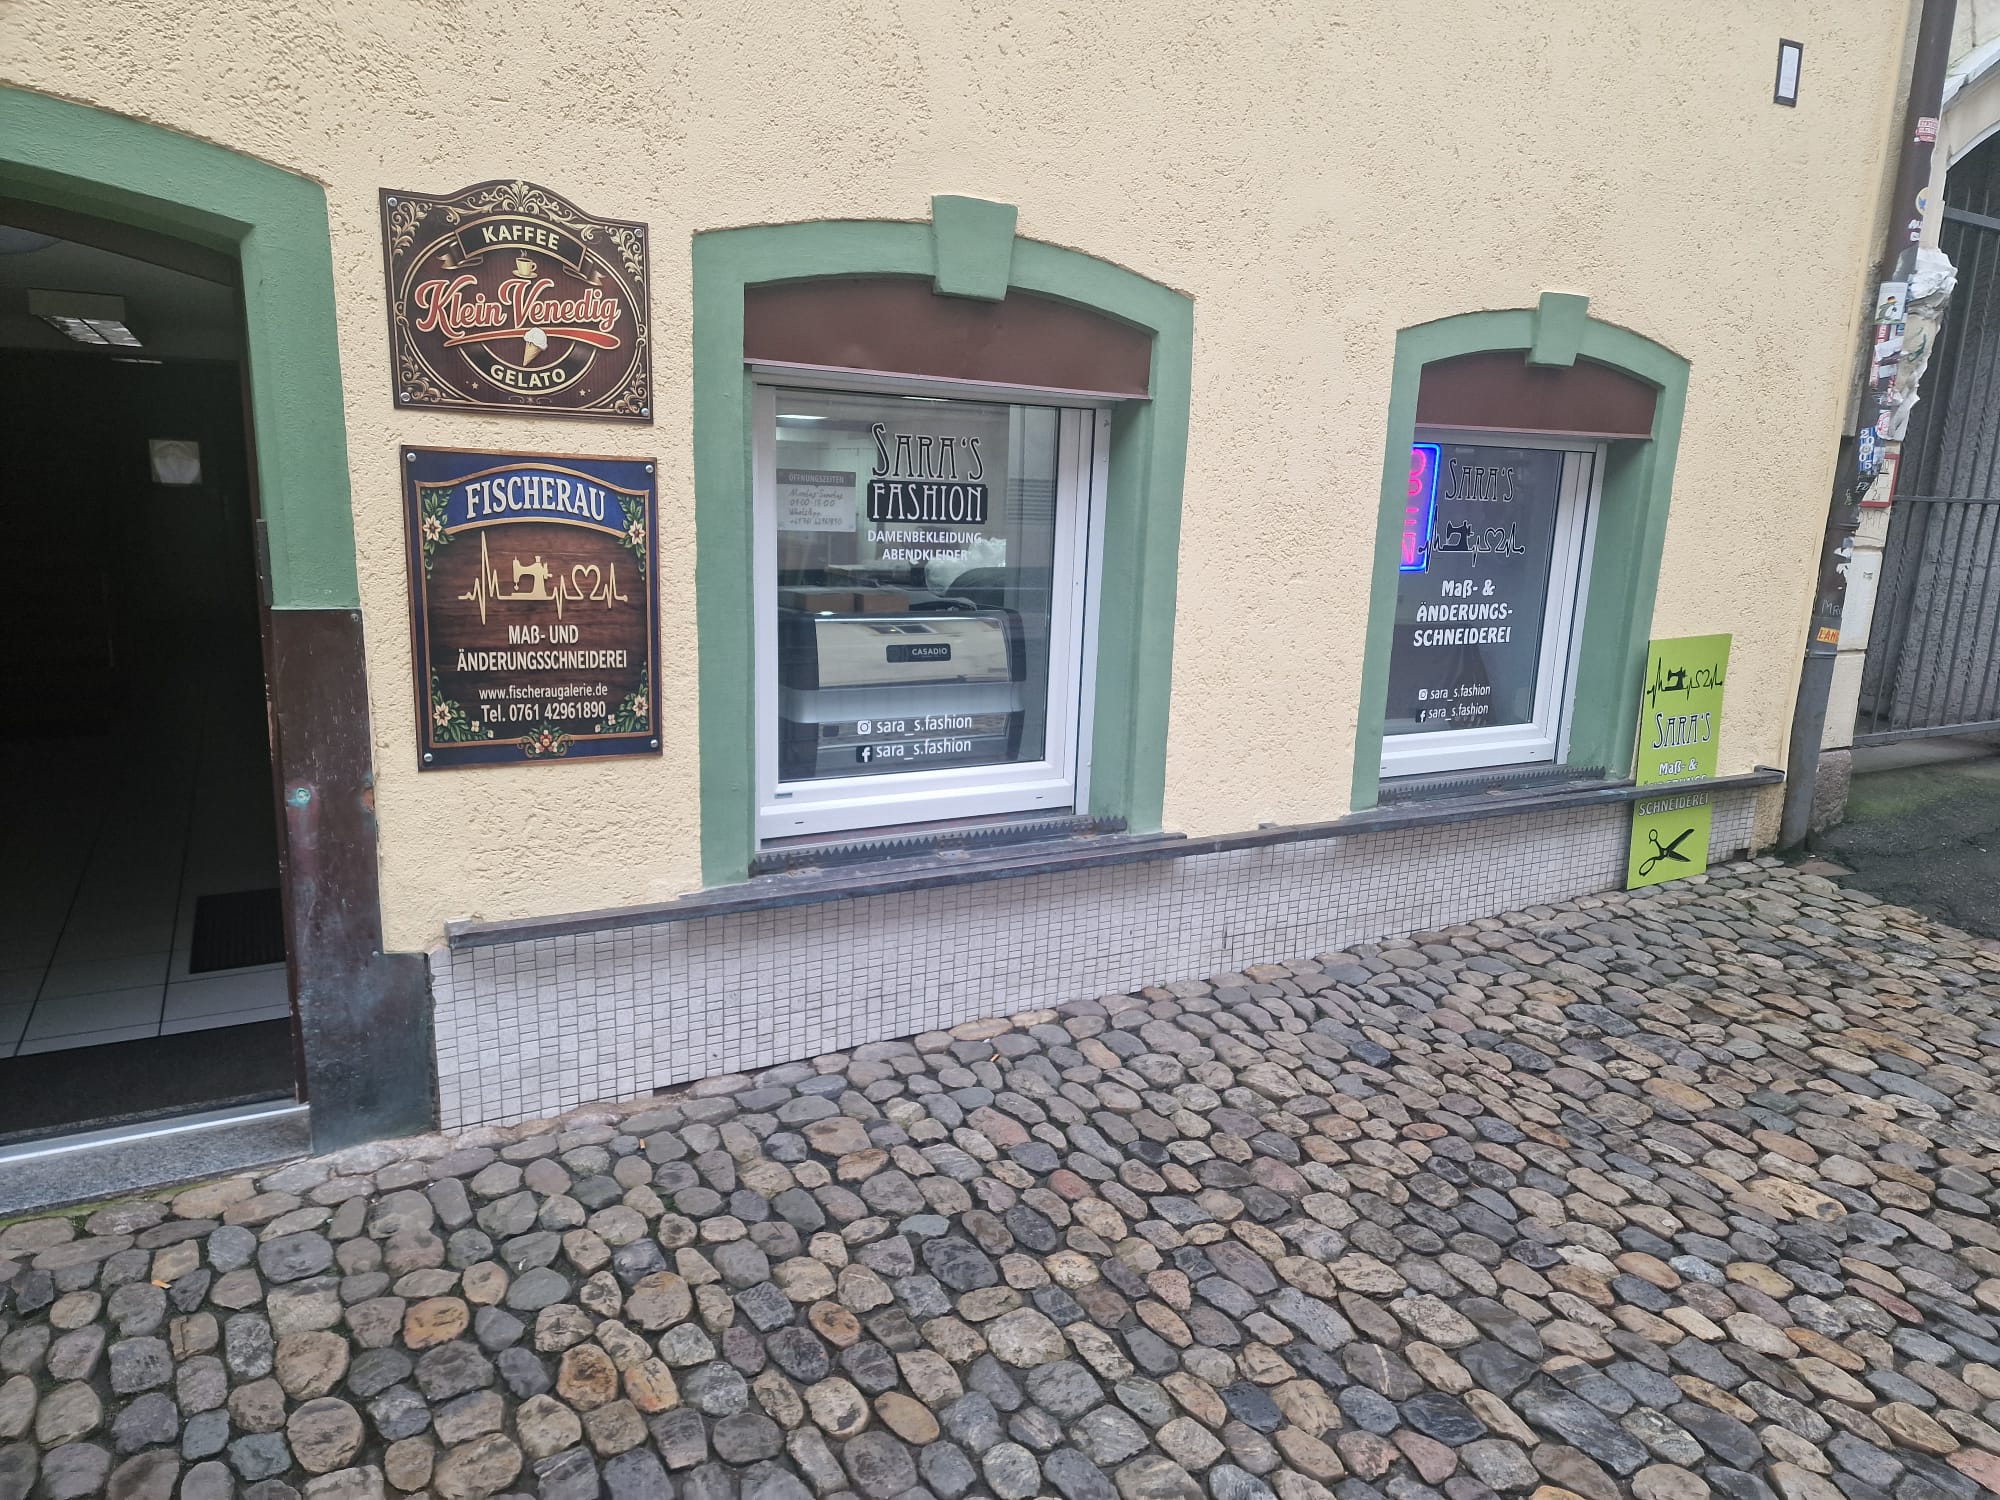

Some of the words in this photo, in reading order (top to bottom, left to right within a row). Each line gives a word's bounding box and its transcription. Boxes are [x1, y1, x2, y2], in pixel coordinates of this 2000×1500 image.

[482, 225, 560, 251] KAFFEE
[415, 275, 507, 339] Klein
[498, 278, 622, 333] Venedig
[489, 364, 566, 388] GELATO
[871, 422, 984, 481] SARA'S
[1445, 457, 1514, 503] SARA'S
[465, 476, 606, 521] FISCHERAU
[872, 482, 984, 522] FASHION
[867, 530, 982, 545] DAMENBEKLEIDUNG
[882, 548, 968, 562] ABENDKLEIDER
[1482, 579, 1496, 597] &
[1416, 602, 1513, 623] ÄNDERUNGS-
[549, 625, 579, 644] UND
[1413, 626, 1512, 647] SCHNEIDEREI
[457, 648, 627, 672] ÄNDERUNGSSCHNEIDEREI
[911, 647, 948, 656] CASADIO
[478, 682, 608, 701] www.fischeraugalerie.de
[1430, 684, 1491, 702] sara_s.fashion
[481, 705, 506, 723] Tel.
[509, 704, 540, 721] 0761
[545, 701, 606, 720] 42961890
[1428, 703, 1489, 721] sara_s.fashion
[876, 714, 972, 736] sara_s.fashion
[1653, 712, 1712, 749] SARA'S
[876, 737, 972, 760] sara_s.fashion
[1688, 758, 1698, 771] &
[1639, 792, 1710, 816] SCHNEIDEREI
